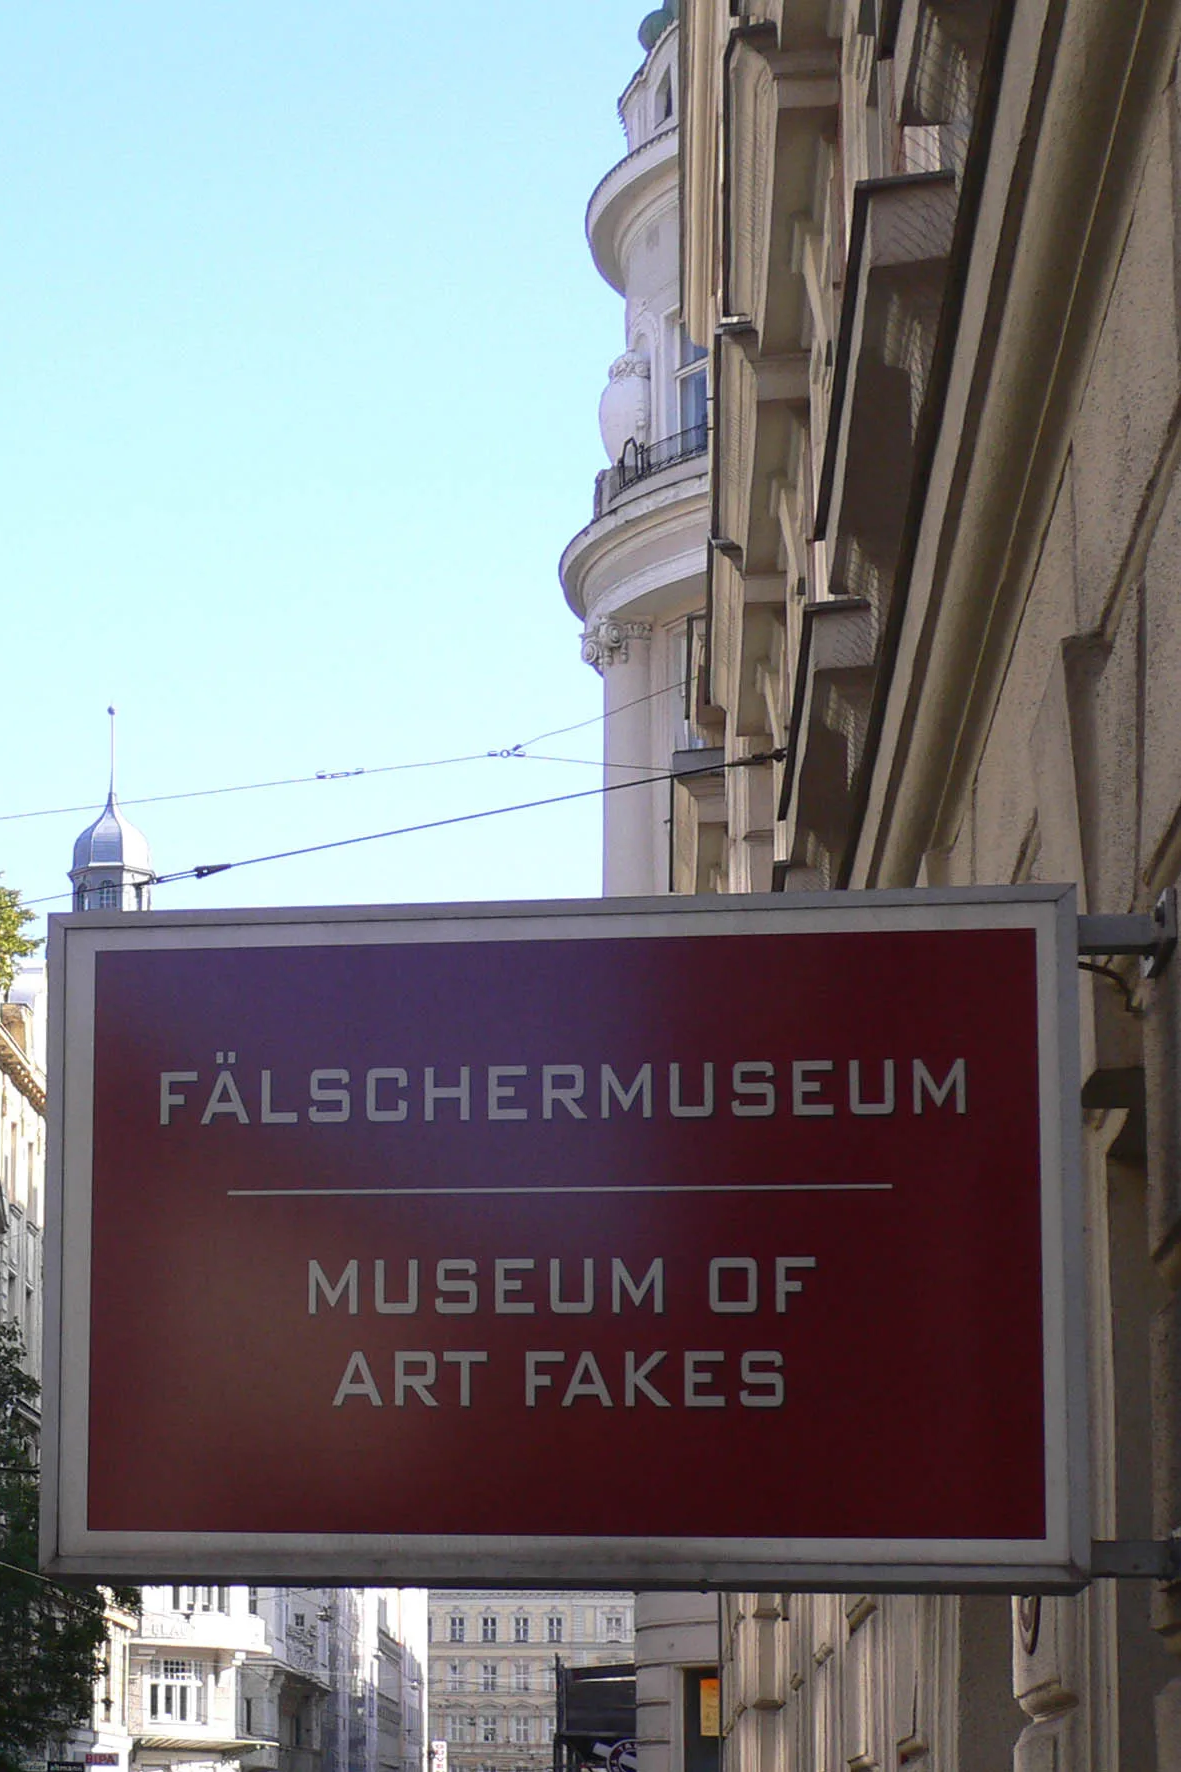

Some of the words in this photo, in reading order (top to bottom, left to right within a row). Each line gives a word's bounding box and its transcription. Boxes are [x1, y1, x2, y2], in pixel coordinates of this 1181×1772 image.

[160, 1051, 967, 1126] FÄLSCHERMUSEUM
[308, 1257, 666, 1315] MUSEUM
[709, 1256, 817, 1314] OF
[332, 1350, 488, 1407] ART
[525, 1350, 786, 1408] FAKES
[85, 1753, 116, 1764] BIPA
